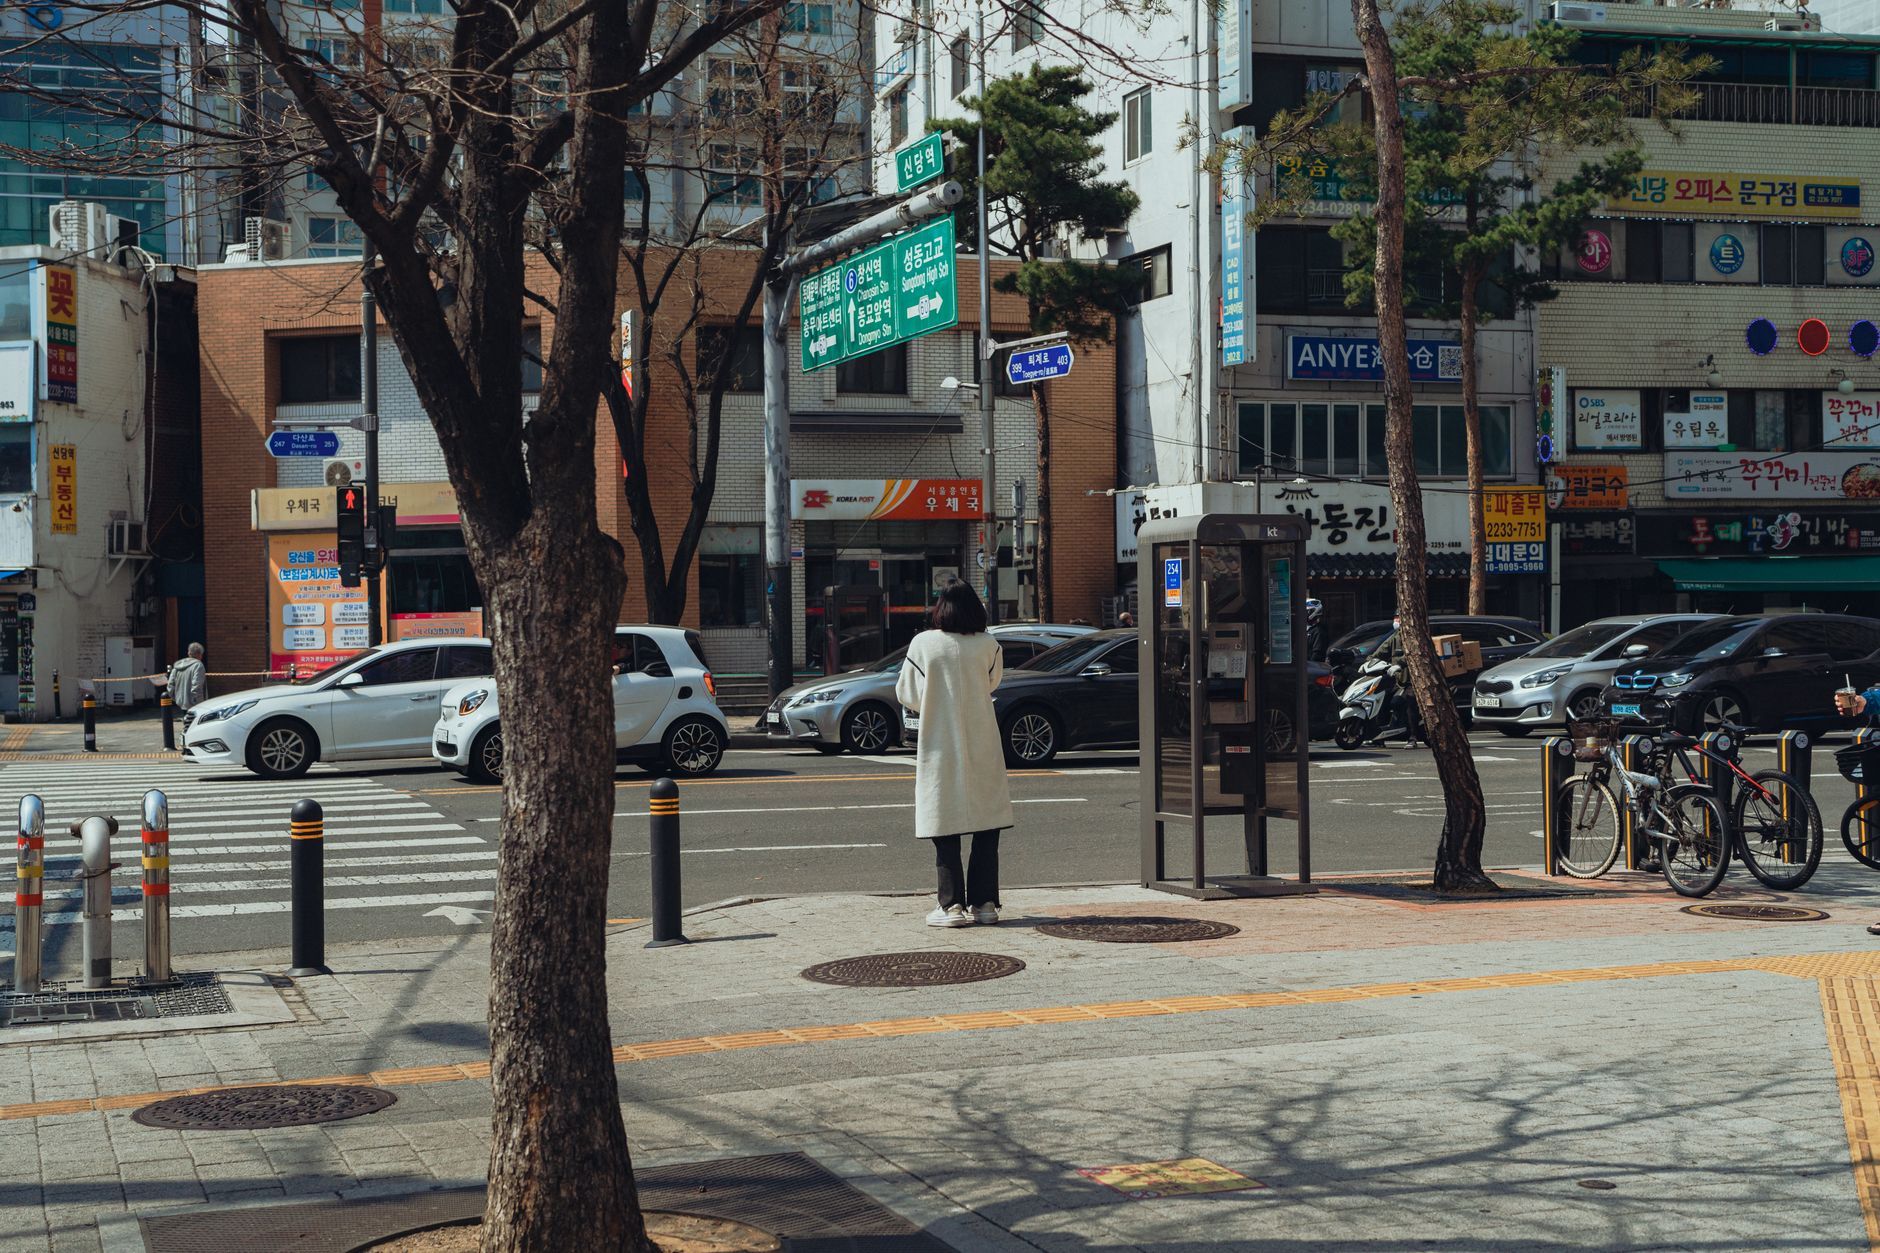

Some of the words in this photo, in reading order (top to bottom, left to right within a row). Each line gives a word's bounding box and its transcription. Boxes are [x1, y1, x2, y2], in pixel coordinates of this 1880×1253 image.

[904, 144, 935, 180] 신당역
[1631, 176, 1669, 203] 신당
[1673, 178, 1734, 203] 오피스
[1738, 180, 1797, 206] 문구점
[903, 236, 944, 272] 성동고교
[1585, 243, 1600, 264] 아
[1719, 246, 1735, 264] 트
[857, 256, 882, 285] 창신역
[902, 271, 926, 293] Sungdong
[926, 265, 938, 285] High
[938, 260, 949, 278] Sch
[50, 271, 73, 318] 꽃
[857, 284, 880, 303] Changsin
[880, 279, 890, 295] Stn
[858, 296, 892, 328] 동묘앞역
[804, 305, 842, 338] 충무아트센터
[858, 328, 881, 346] Dongmyo
[882, 323, 892, 338] Stn
[1028, 352, 1050, 366] 퇴계로
[1057, 355, 1068, 366] 403
[1012, 363, 1022, 374] 399
[1590, 398, 1605, 407] SBS
[1579, 412, 1637, 430] 리얼코리아
[274, 441, 286, 450] 247
[293, 434, 316, 443] 다산로
[324, 441, 336, 450] 251
[53, 447, 75, 460] 신당역
[1739, 458, 1809, 491] 쭈꾸미
[56, 465, 73, 520] 부동산
[286, 497, 321, 513] 우체국
[925, 498, 979, 512] 우체국
[1495, 491, 1541, 516] 파출부
[1267, 527, 1278, 537] kt
[1487, 522, 1541, 537] 2233-7751
[1802, 517, 1850, 546] 김밥
[288, 551, 315, 564] 당신을
[317, 550, 338, 564] 우체
[1168, 563, 1179, 575] 254
[1485, 563, 1544, 572] 10-9095-5960
